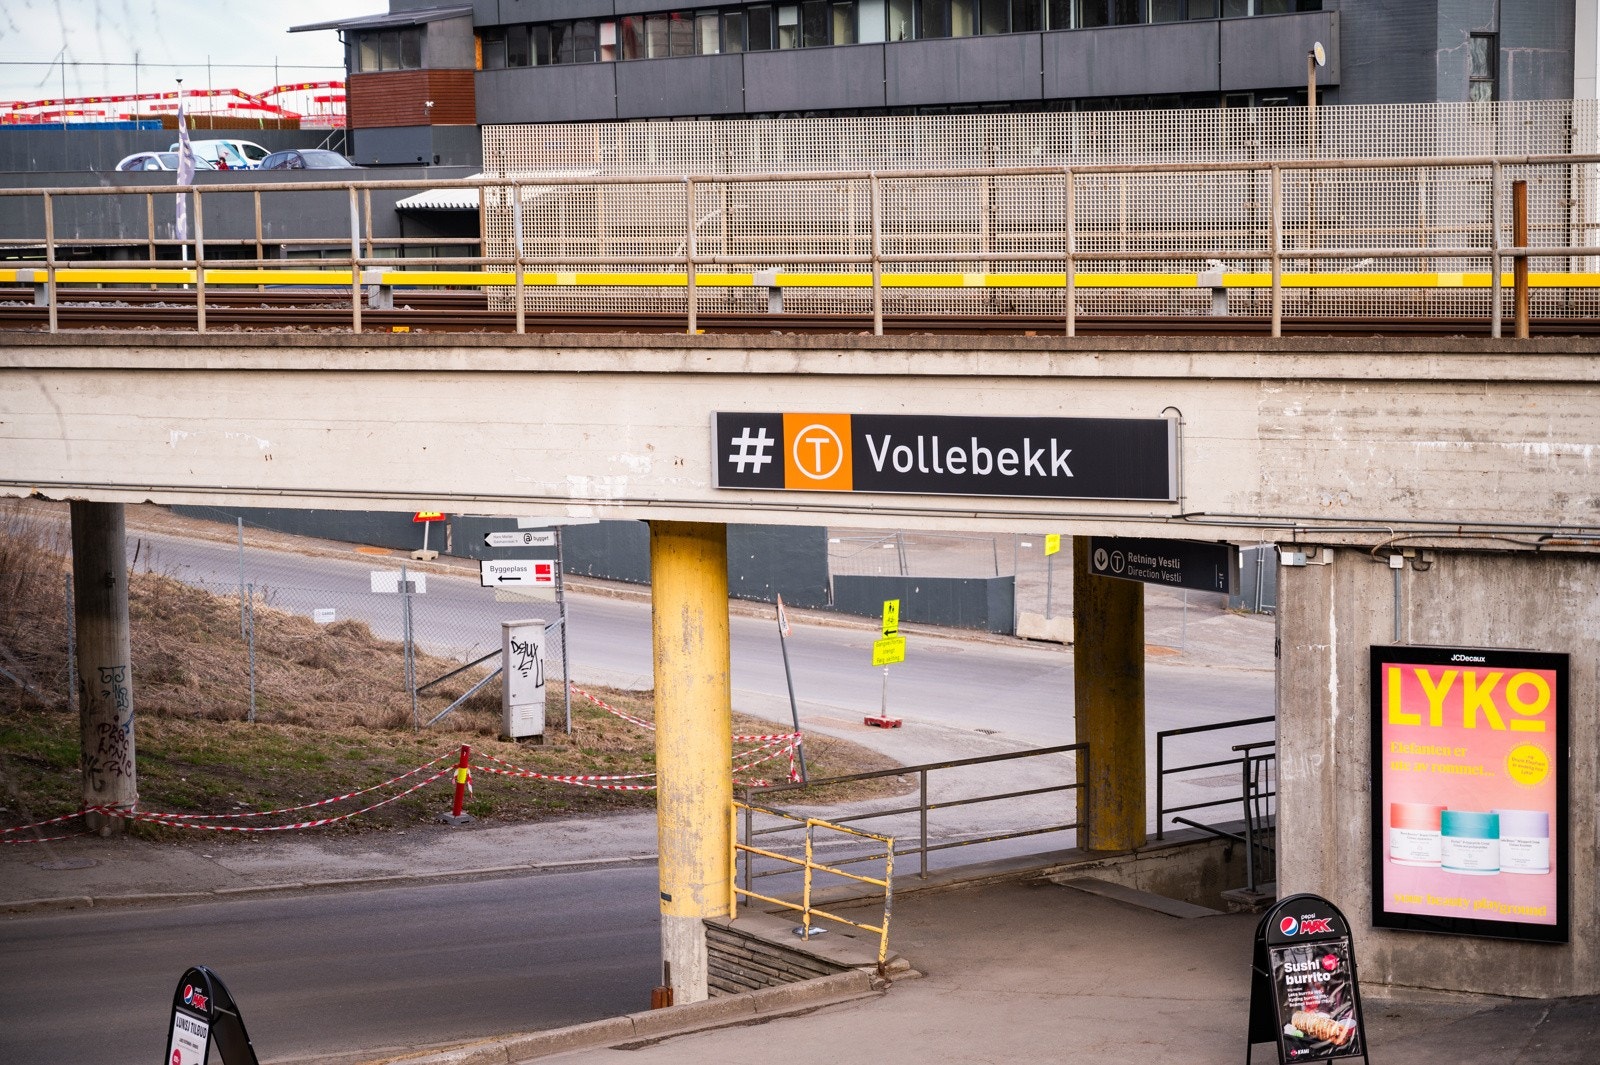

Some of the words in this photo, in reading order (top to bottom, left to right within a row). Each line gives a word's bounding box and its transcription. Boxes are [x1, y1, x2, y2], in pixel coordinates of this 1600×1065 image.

[865, 433, 1074, 477] Vollebekk
[1127, 551, 1157, 568] Retning
[1158, 555, 1181, 569] Vestli
[489, 565, 528, 574] Byggeplass
[1127, 565, 1160, 580] Direction
[1160, 570, 1182, 583] Vestli
[1218, 580, 1223, 589] 1
[1450, 653, 1486, 663] JCDecaux
[1388, 667, 1551, 733] LYKO
[1390, 741, 1451, 758] Elefanten
[1453, 746, 1468, 758] er
[1390, 761, 1410, 772] ute
[1412, 762, 1428, 773] av
[1393, 893, 1423, 906] your
[1426, 893, 1471, 910] beauty
[1473, 897, 1547, 917] playground
[1300, 917, 1333, 935] MAX
[1283, 959, 1320, 973] Sushi
[1285, 971, 1331, 986] burrito
